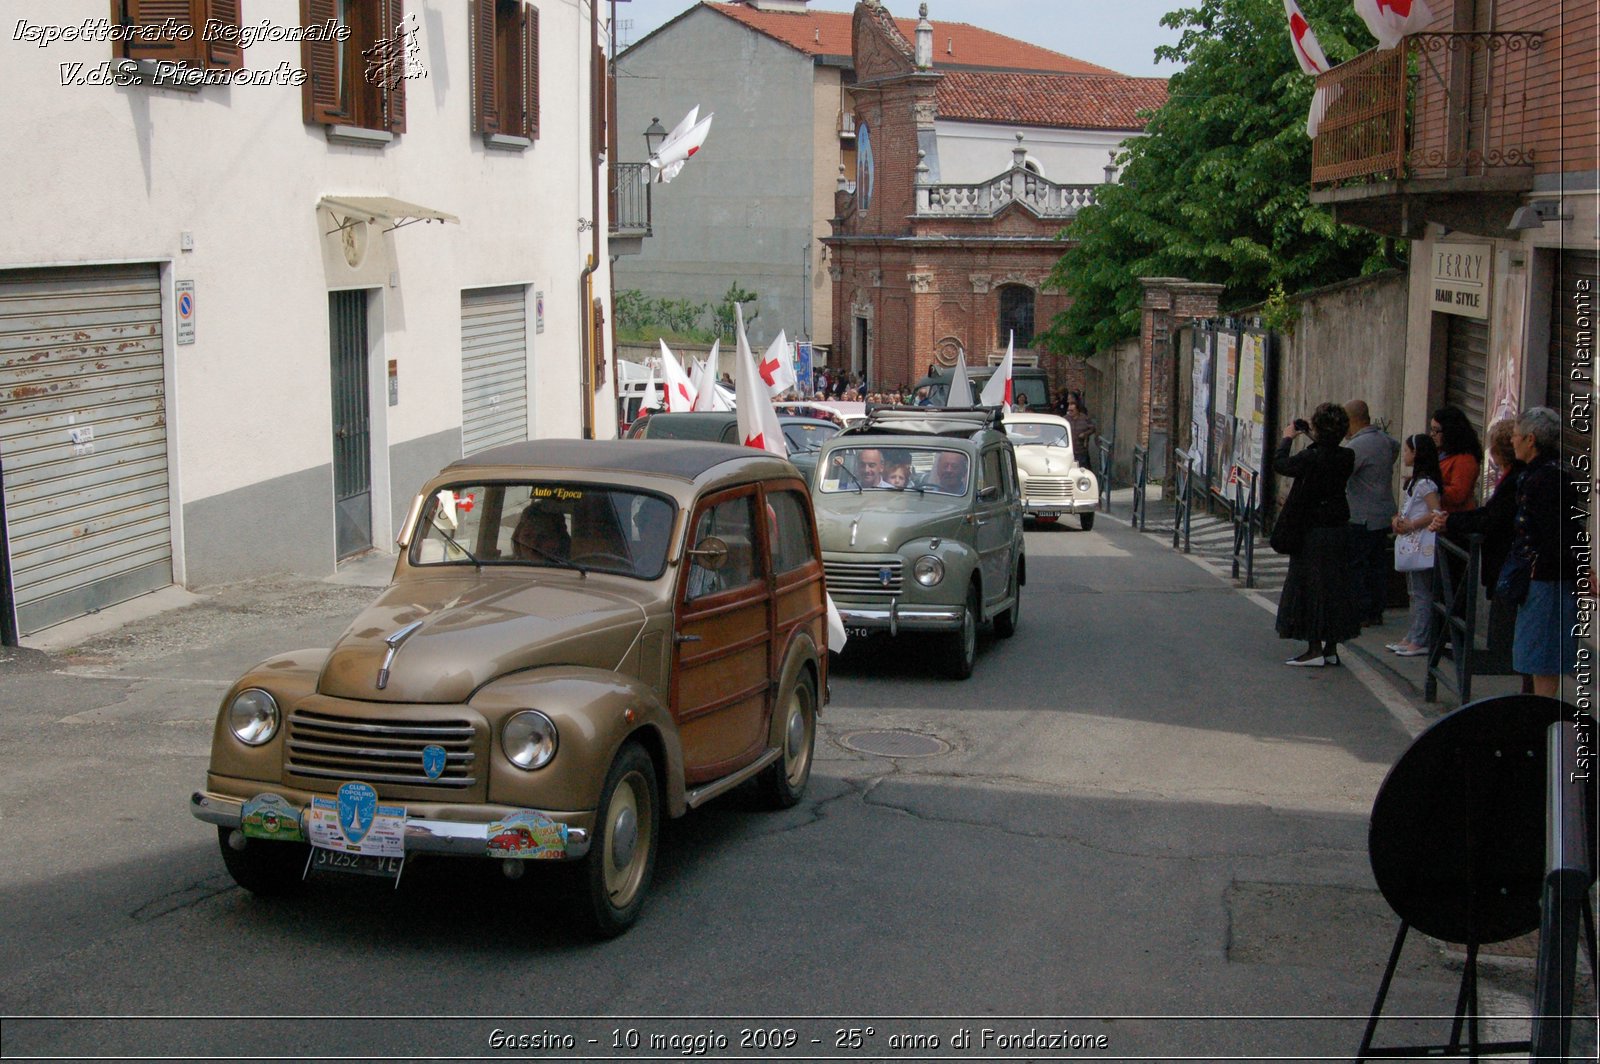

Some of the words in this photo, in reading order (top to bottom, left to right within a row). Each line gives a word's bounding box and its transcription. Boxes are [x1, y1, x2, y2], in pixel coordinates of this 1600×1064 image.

[1437, 252, 1482, 279] TERRY
[1435, 288, 1453, 303] HAIR
[1456, 291, 1480, 308] STYLE
[532, 487, 551, 497] Auto
[341, 789, 374, 798] TOPOLINO
